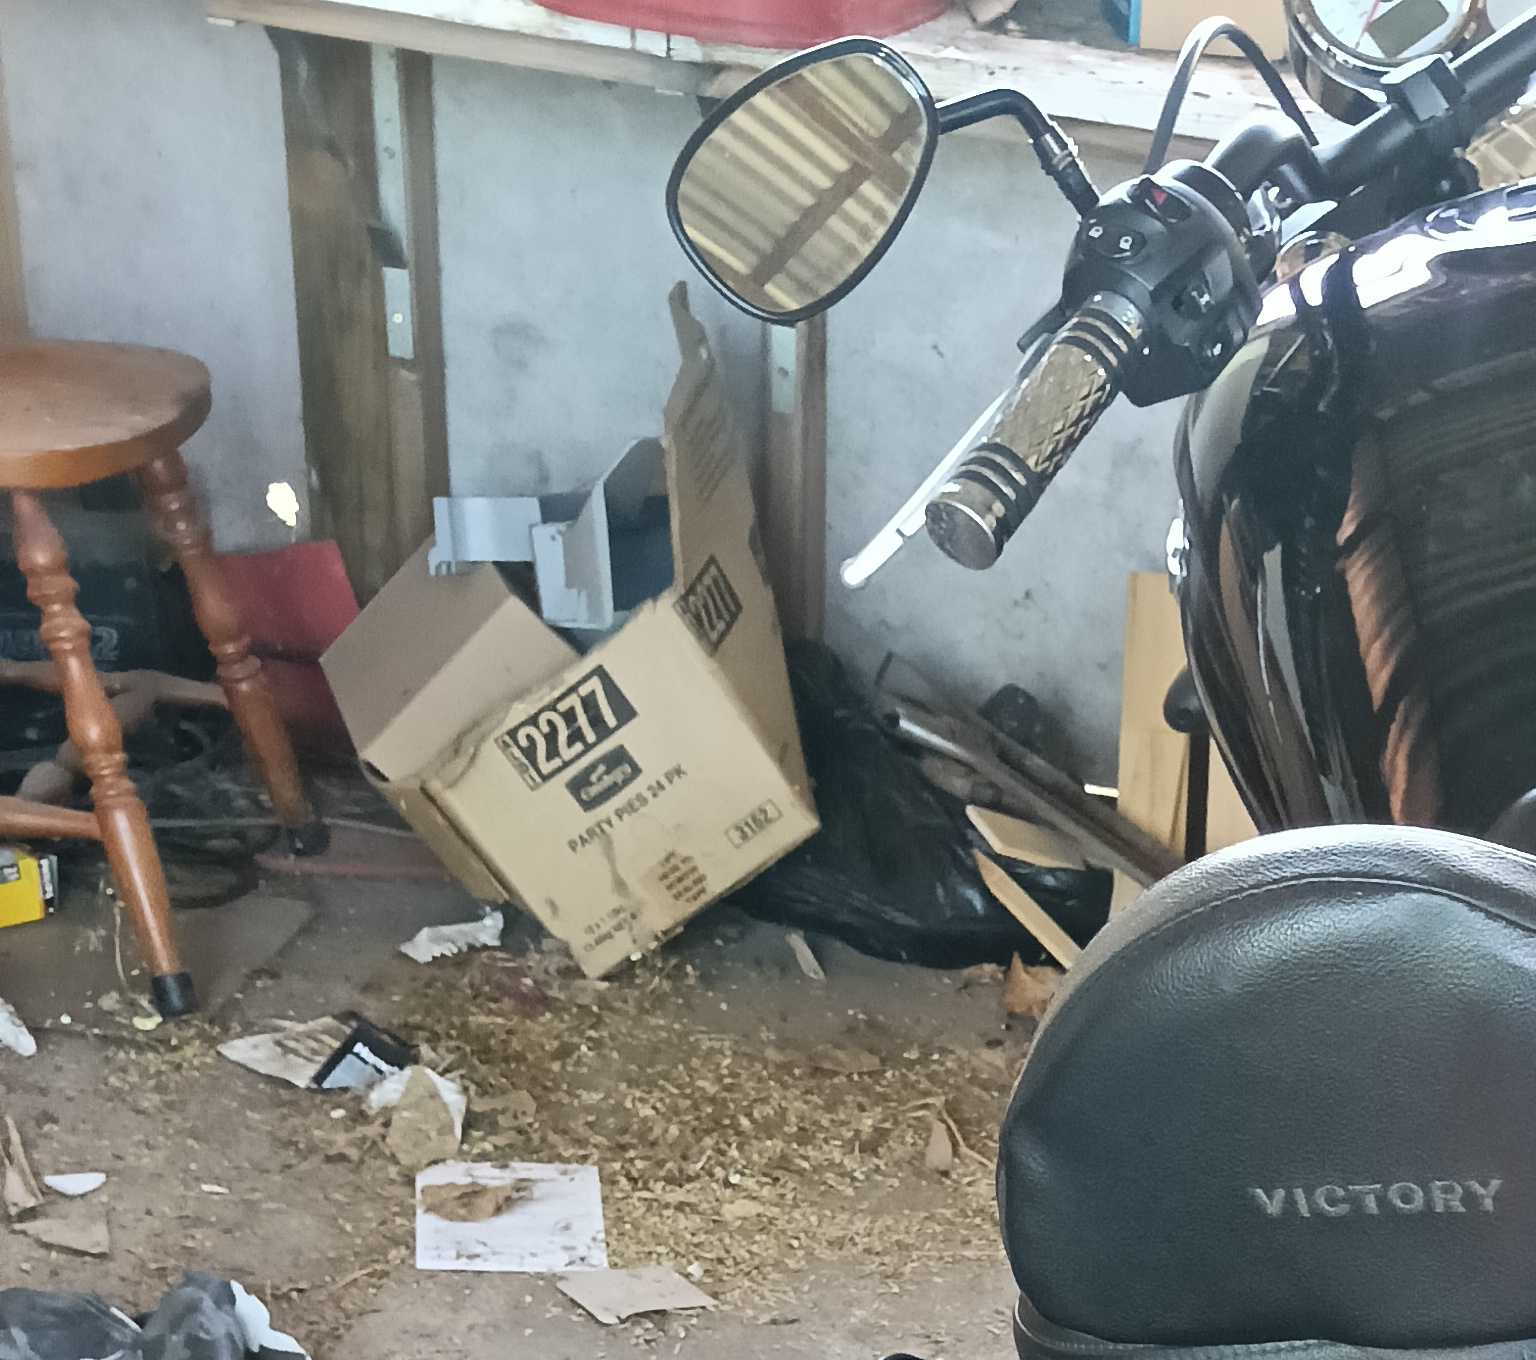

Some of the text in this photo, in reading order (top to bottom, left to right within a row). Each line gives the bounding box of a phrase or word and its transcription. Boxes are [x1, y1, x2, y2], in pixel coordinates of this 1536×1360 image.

[516, 674, 618, 776] 2277
[567, 815, 614, 853] PARTY
[614, 792, 649, 822] PIES
[647, 779, 666, 798] 24
[663, 763, 688, 785] PK
[1249, 1179, 1503, 1217] VICTORY
